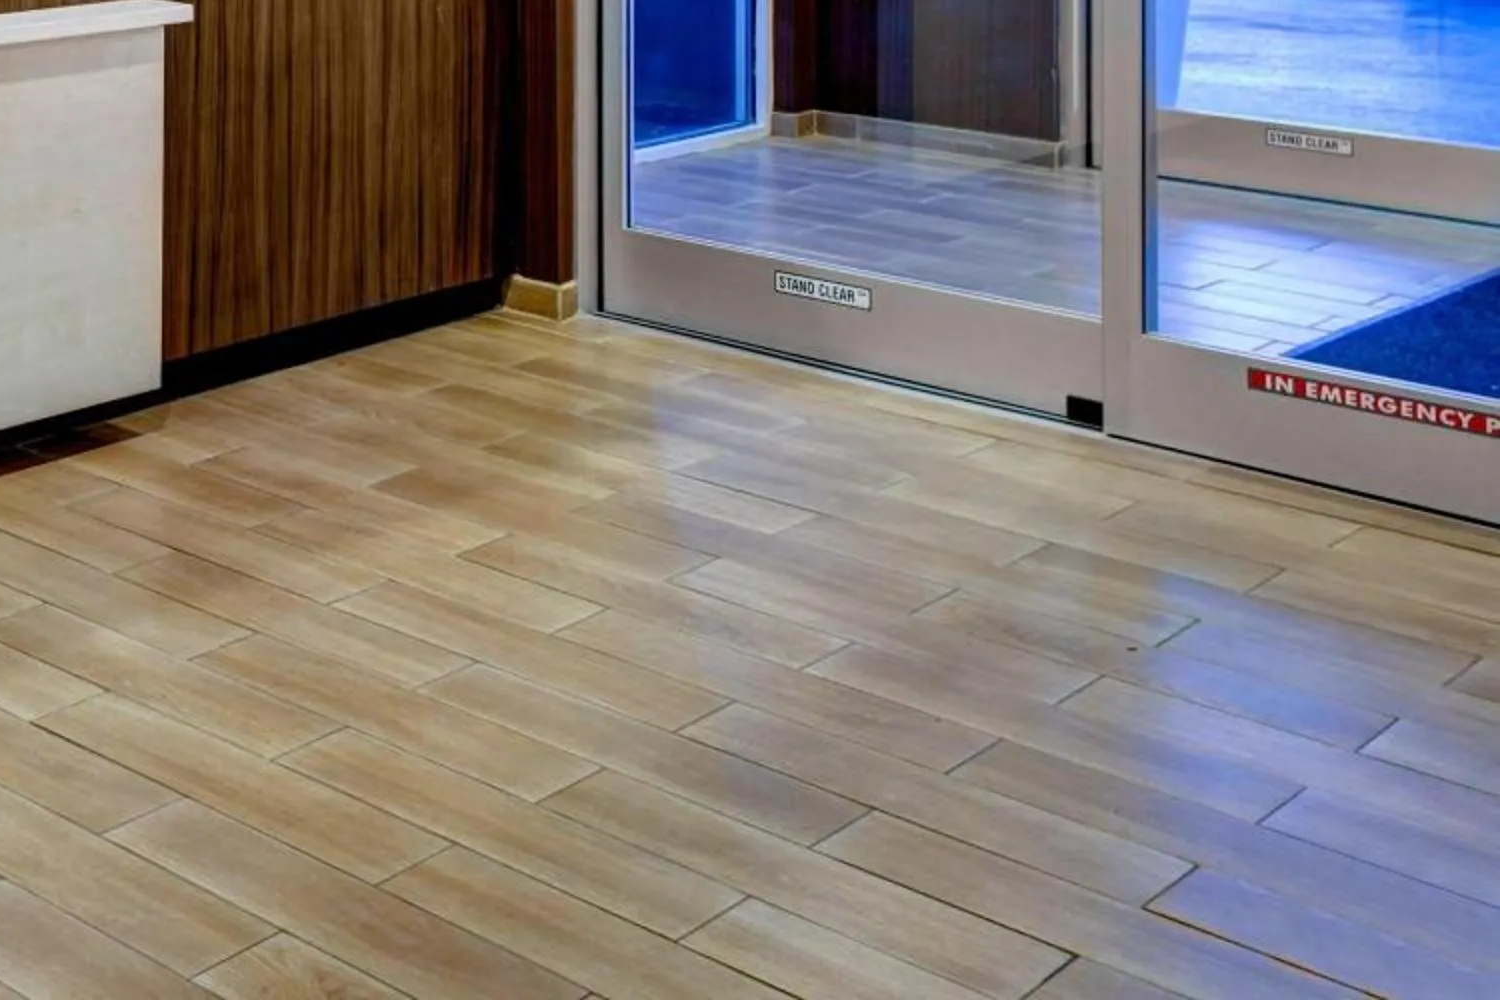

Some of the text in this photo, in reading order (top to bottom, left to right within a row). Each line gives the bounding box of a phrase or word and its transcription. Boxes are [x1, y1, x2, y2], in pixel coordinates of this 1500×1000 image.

[1270, 132, 1339, 150] STAND CLEAR
[779, 275, 855, 303] STAND CLEAR
[1263, 373, 1294, 394] IN
[1306, 381, 1474, 429] EMERGENCY
